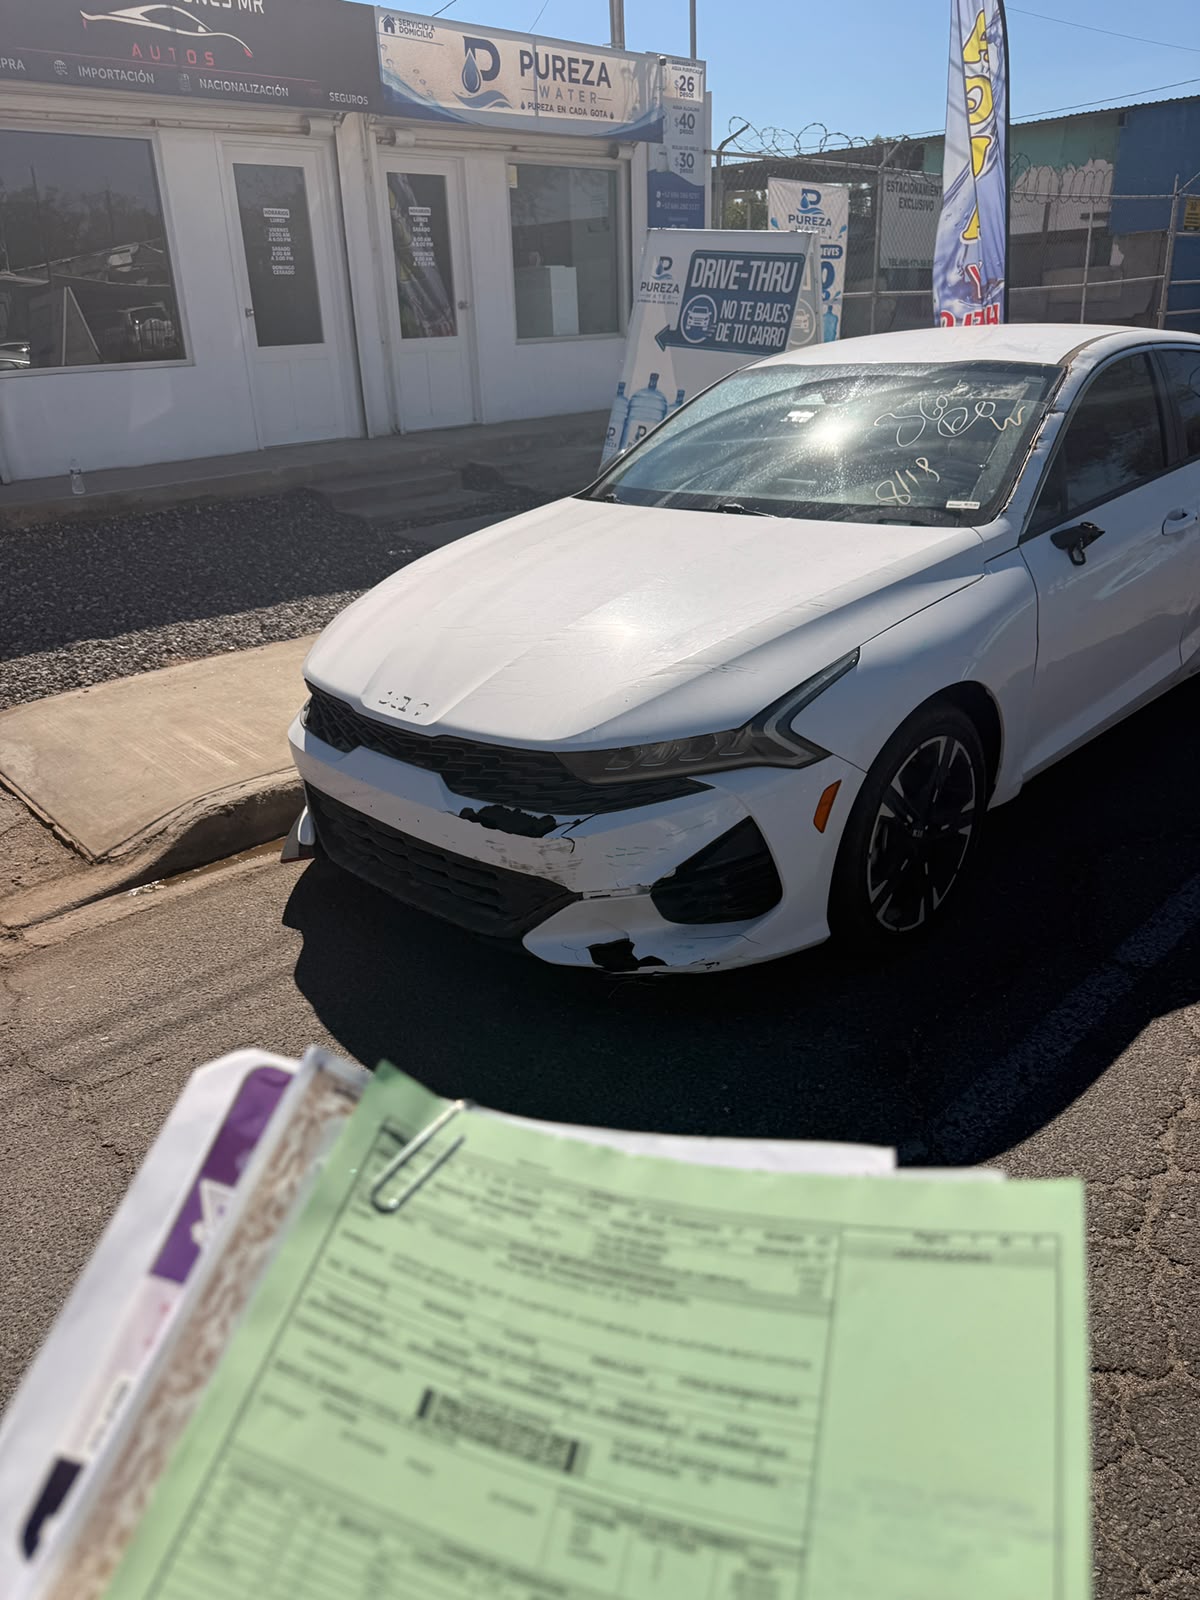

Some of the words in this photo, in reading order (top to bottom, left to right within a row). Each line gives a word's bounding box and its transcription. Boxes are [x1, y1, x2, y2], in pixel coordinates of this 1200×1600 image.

[398, 18, 429, 30] SERVICIO
[430, 24, 436, 33] A
[399, 26, 434, 39] DOMICILIO
[131, 43, 215, 66] AUTOS
[519, 49, 612, 89] PUREZA
[0, 56, 26, 72] PRA
[77, 65, 155, 84] IMPORTACIÓN
[199, 77, 289, 97] NACIONALIZACIÓN
[329, 91, 369, 106] SEGUROS
[674, 74, 695, 93] $26
[539, 85, 598, 105] WATER
[527, 102, 554, 113] PUREZA
[557, 105, 567, 113] EN
[569, 106, 588, 116] CADA
[590, 108, 609, 118] GOTA
[674, 112, 696, 130] $40
[674, 152, 695, 169] $30
[886, 180, 943, 198] ESTACIONAMIENT
[788, 214, 832, 227] PUREZA
[820, 246, 840, 257] EVES
[691, 257, 799, 294] DRIVE-THRU
[639, 281, 680, 295] PUREZA
[719, 299, 738, 320] NO
[739, 301, 756, 321] TE
[754, 303, 791, 324] BAJES
[714, 323, 732, 343] DE
[732, 324, 749, 344] TU
[747, 325, 787, 348] CARRO
